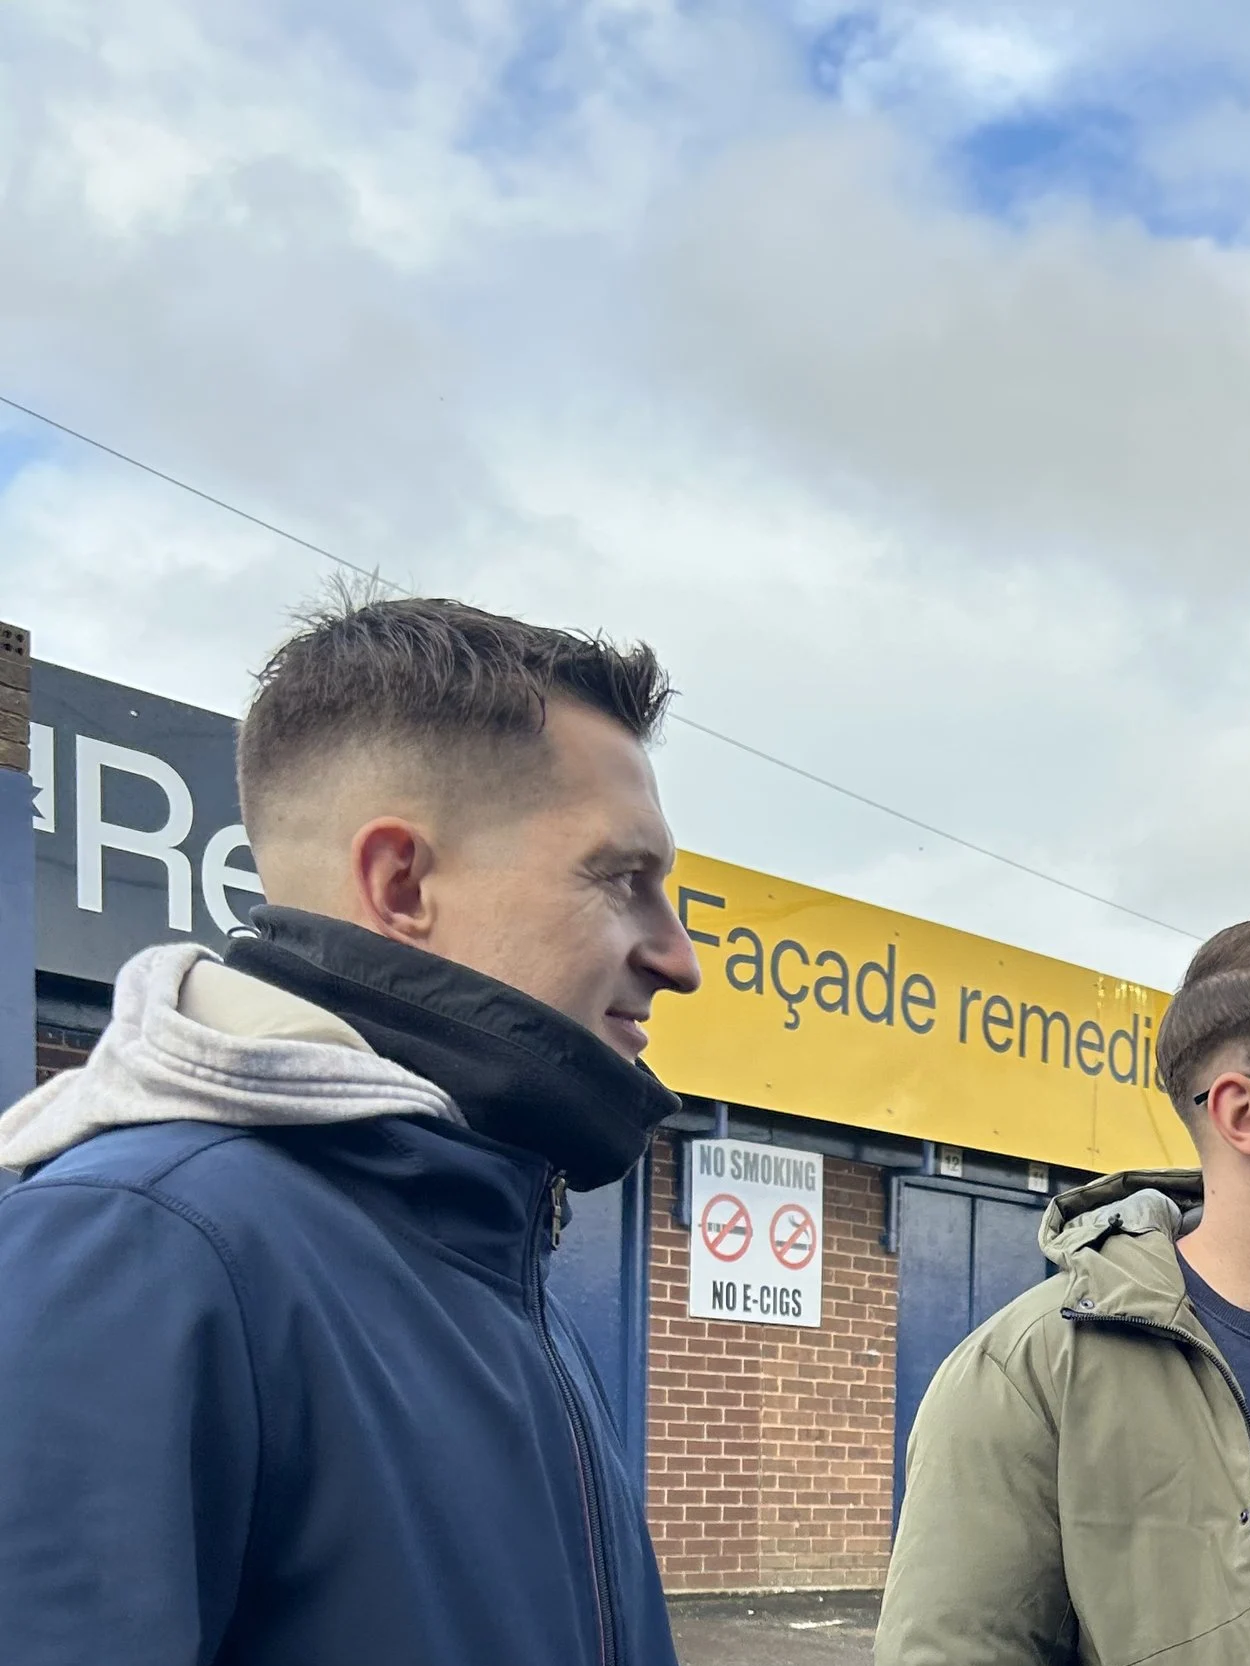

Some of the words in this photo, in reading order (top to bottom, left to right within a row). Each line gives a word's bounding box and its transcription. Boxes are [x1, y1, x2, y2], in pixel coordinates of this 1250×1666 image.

[678, 886, 936, 1034] Façade
[959, 986, 1168, 1093] remedi
[699, 1144, 725, 1178] NO
[730, 1149, 816, 1191] SMOKING
[712, 1280, 737, 1311] NO
[743, 1283, 802, 1318] E-CIGS
